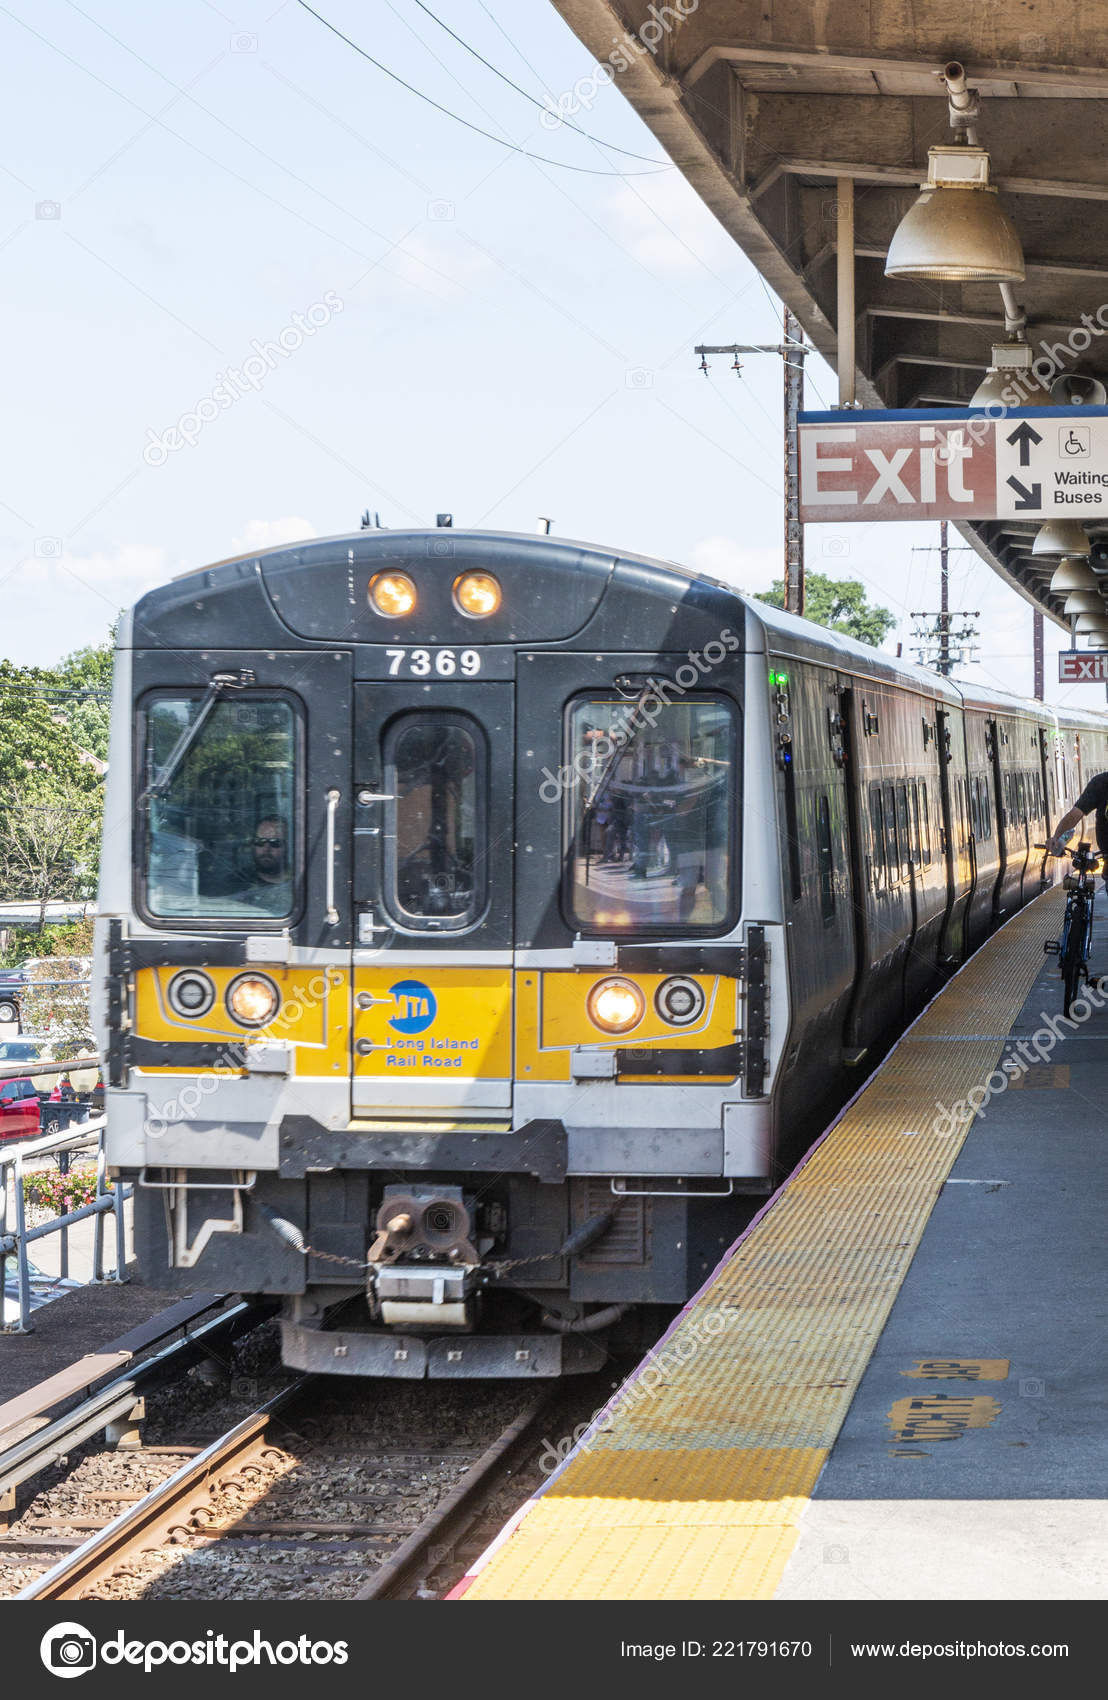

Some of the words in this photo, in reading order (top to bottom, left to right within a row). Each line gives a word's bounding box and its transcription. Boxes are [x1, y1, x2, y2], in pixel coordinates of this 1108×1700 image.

[801, 427, 974, 505] Exit
[1054, 471, 1108, 487] Waiting
[1054, 490, 1102, 504] Buses
[386, 649, 481, 676] 7369
[1060, 655, 1108, 679] Exit
[392, 993, 430, 1020] MTA
[386, 1037, 425, 1051] Long
[431, 1037, 479, 1049] Island
[386, 1055, 416, 1066] Rail
[423, 1055, 462, 1067] Road
